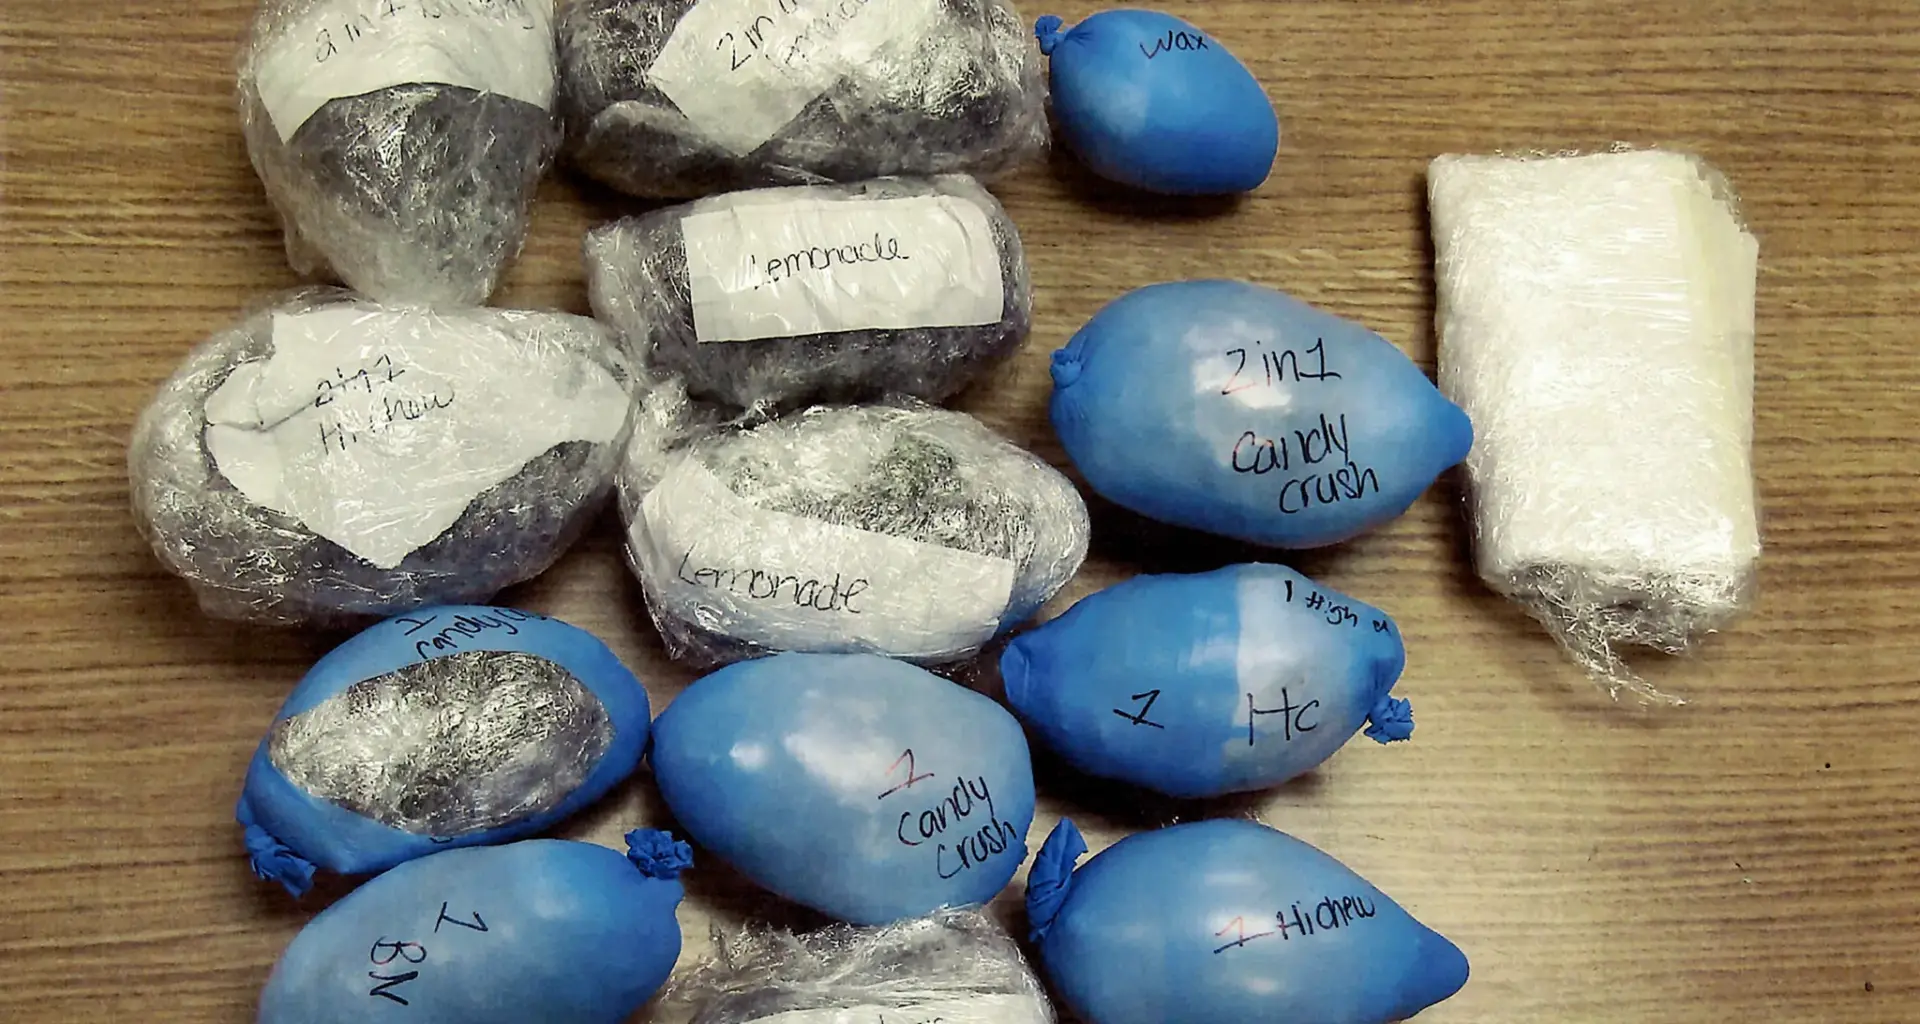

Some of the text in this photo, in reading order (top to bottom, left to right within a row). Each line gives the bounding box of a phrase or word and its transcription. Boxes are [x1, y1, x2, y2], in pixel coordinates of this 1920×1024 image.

[1221, 337, 1342, 395] 2in1
[1279, 460, 1380, 514] crush
[678, 541, 869, 614] Lemonade
[1112, 689, 1165, 729] 1
[878, 748, 935, 799] 1
[898, 776, 995, 846] candy
[937, 817, 1017, 880] crush
